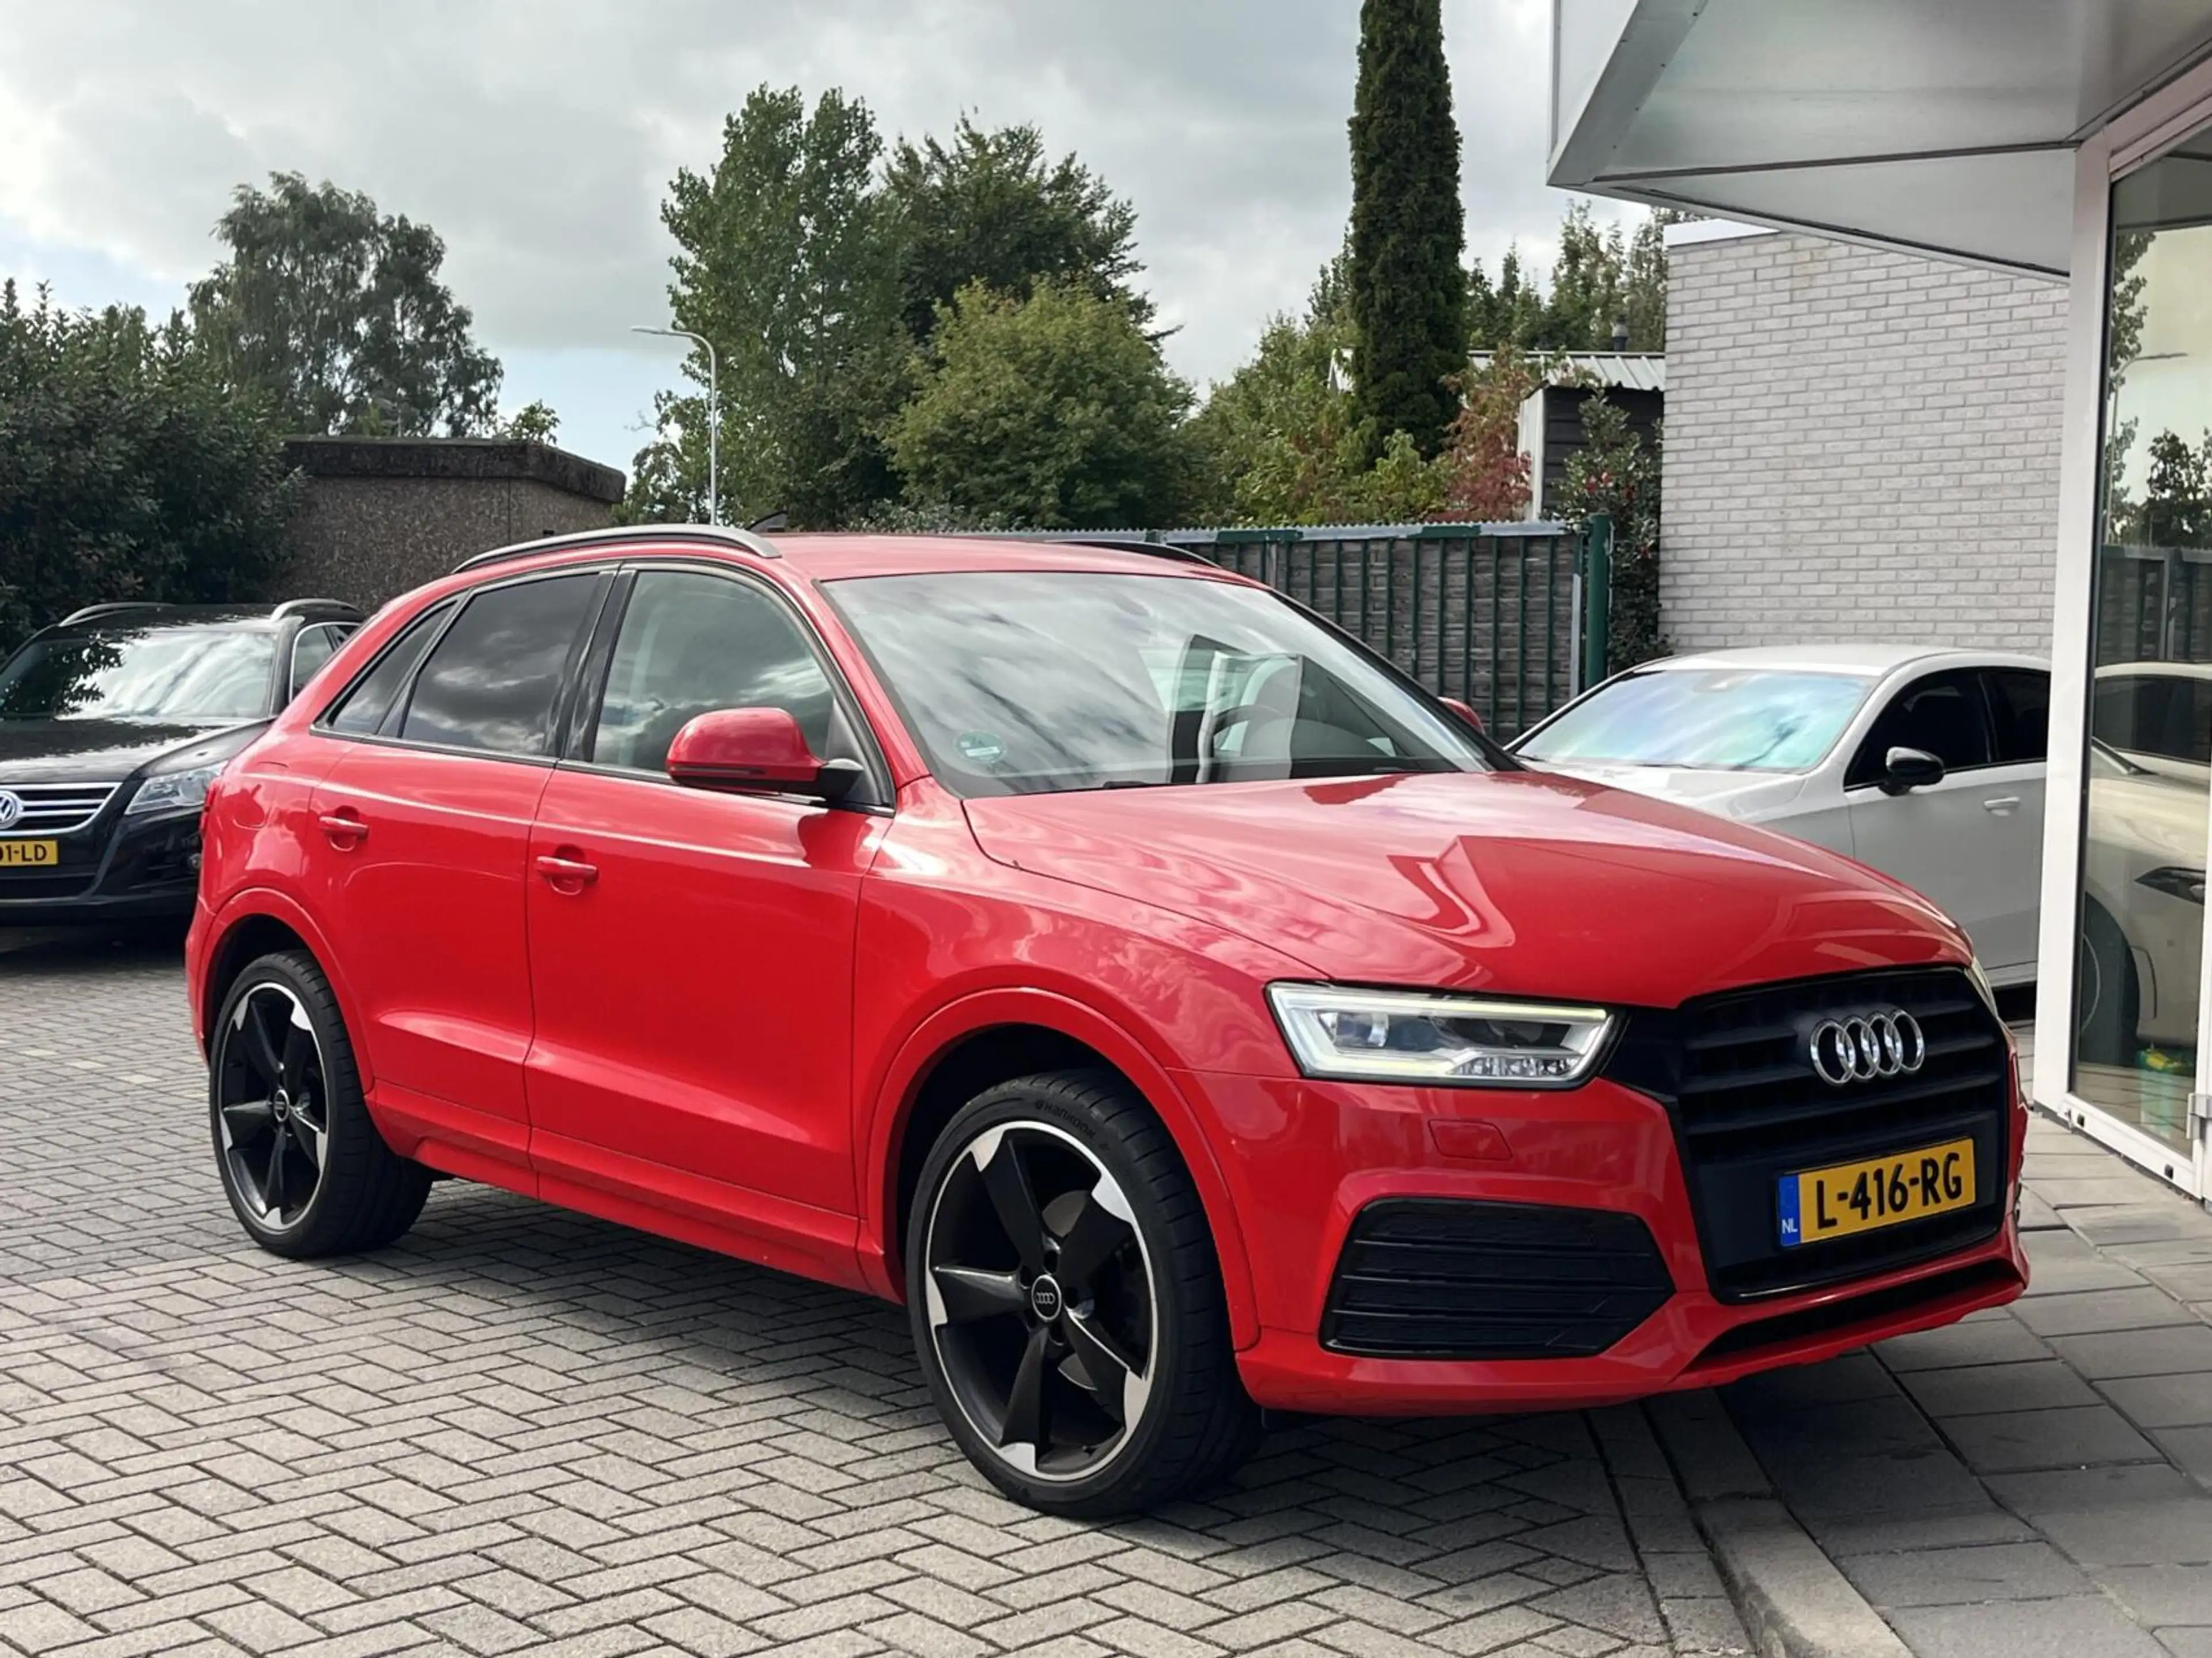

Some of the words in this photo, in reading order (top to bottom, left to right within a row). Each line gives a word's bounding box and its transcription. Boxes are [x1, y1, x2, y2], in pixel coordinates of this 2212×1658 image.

[0, 844, 47, 862] 1-LD
[1816, 1152, 1962, 1230] L-416-RG
[1782, 1217, 1798, 1234] NL
